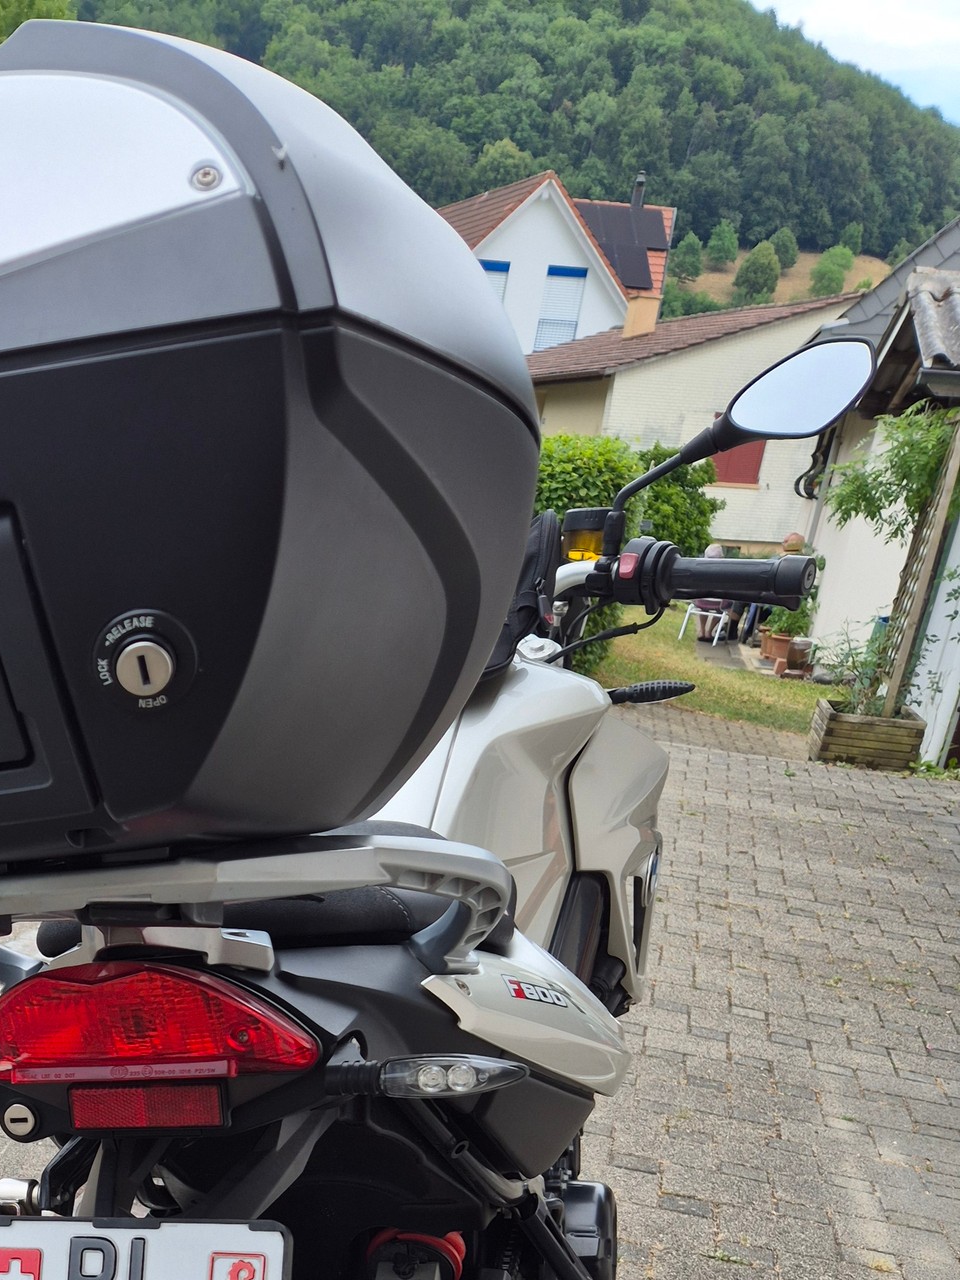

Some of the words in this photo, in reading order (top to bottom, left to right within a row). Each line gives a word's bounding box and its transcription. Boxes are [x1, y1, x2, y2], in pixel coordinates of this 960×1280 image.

[106, 616, 155, 644] RELEASE
[97, 658, 113, 685] LOCK
[138, 695, 167, 708] OPEN
